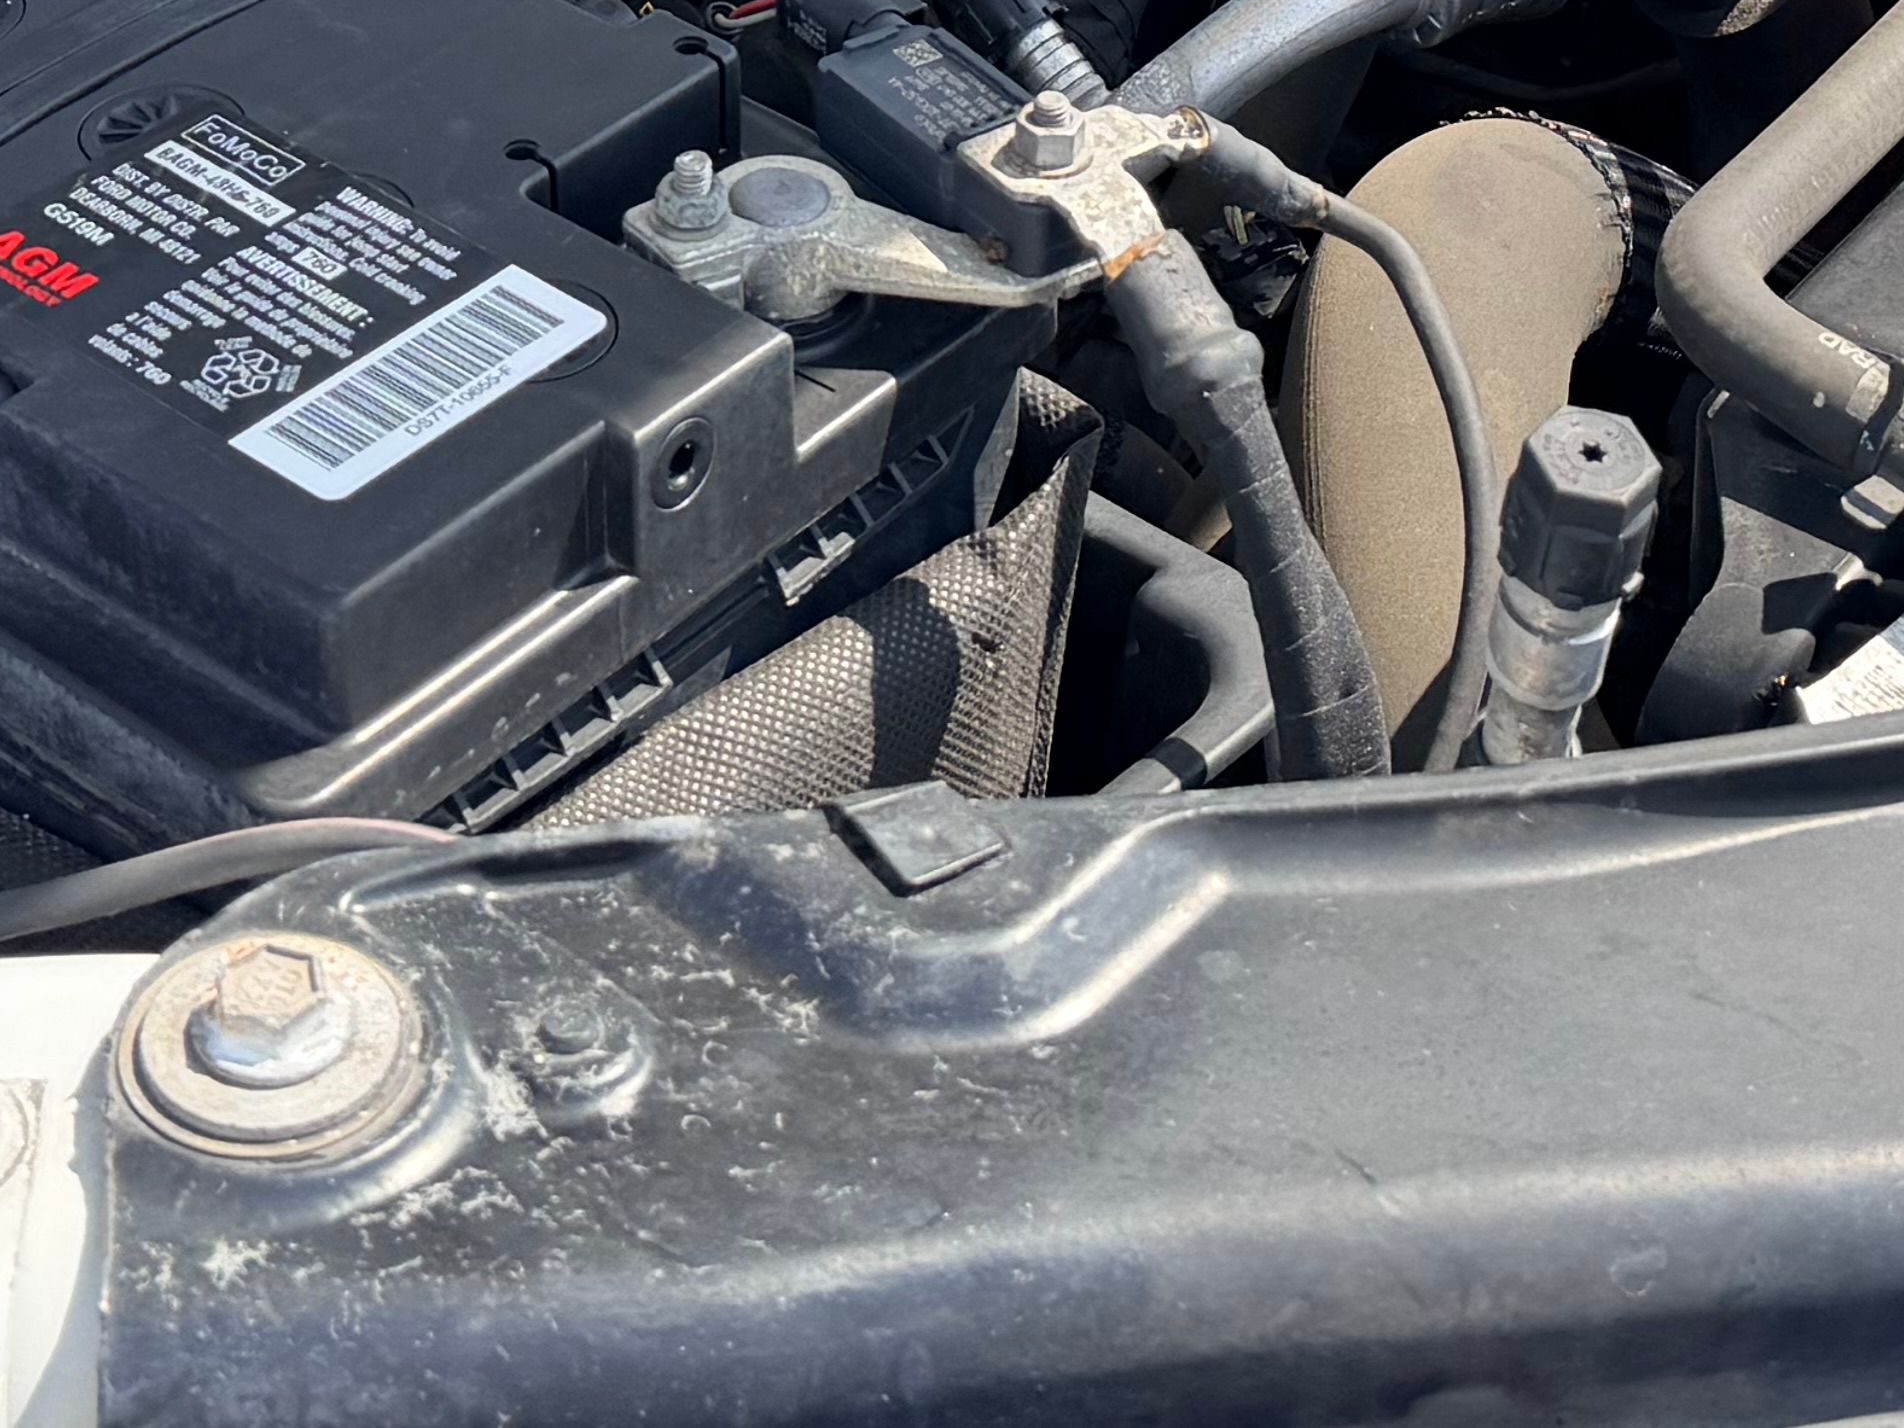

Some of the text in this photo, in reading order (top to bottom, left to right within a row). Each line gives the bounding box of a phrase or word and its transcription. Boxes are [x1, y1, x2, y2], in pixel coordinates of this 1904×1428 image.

[190, 121, 294, 179] FoMoCo
[87, 175, 135, 201] FORD
[121, 194, 180, 227] MOTOR
[140, 180, 174, 199] BY
[330, 186, 422, 236] WARNING:
[38, 200, 117, 247] G519M
[297, 251, 342, 275] 760
[404, 362, 514, 440] DS7T-10655-F
